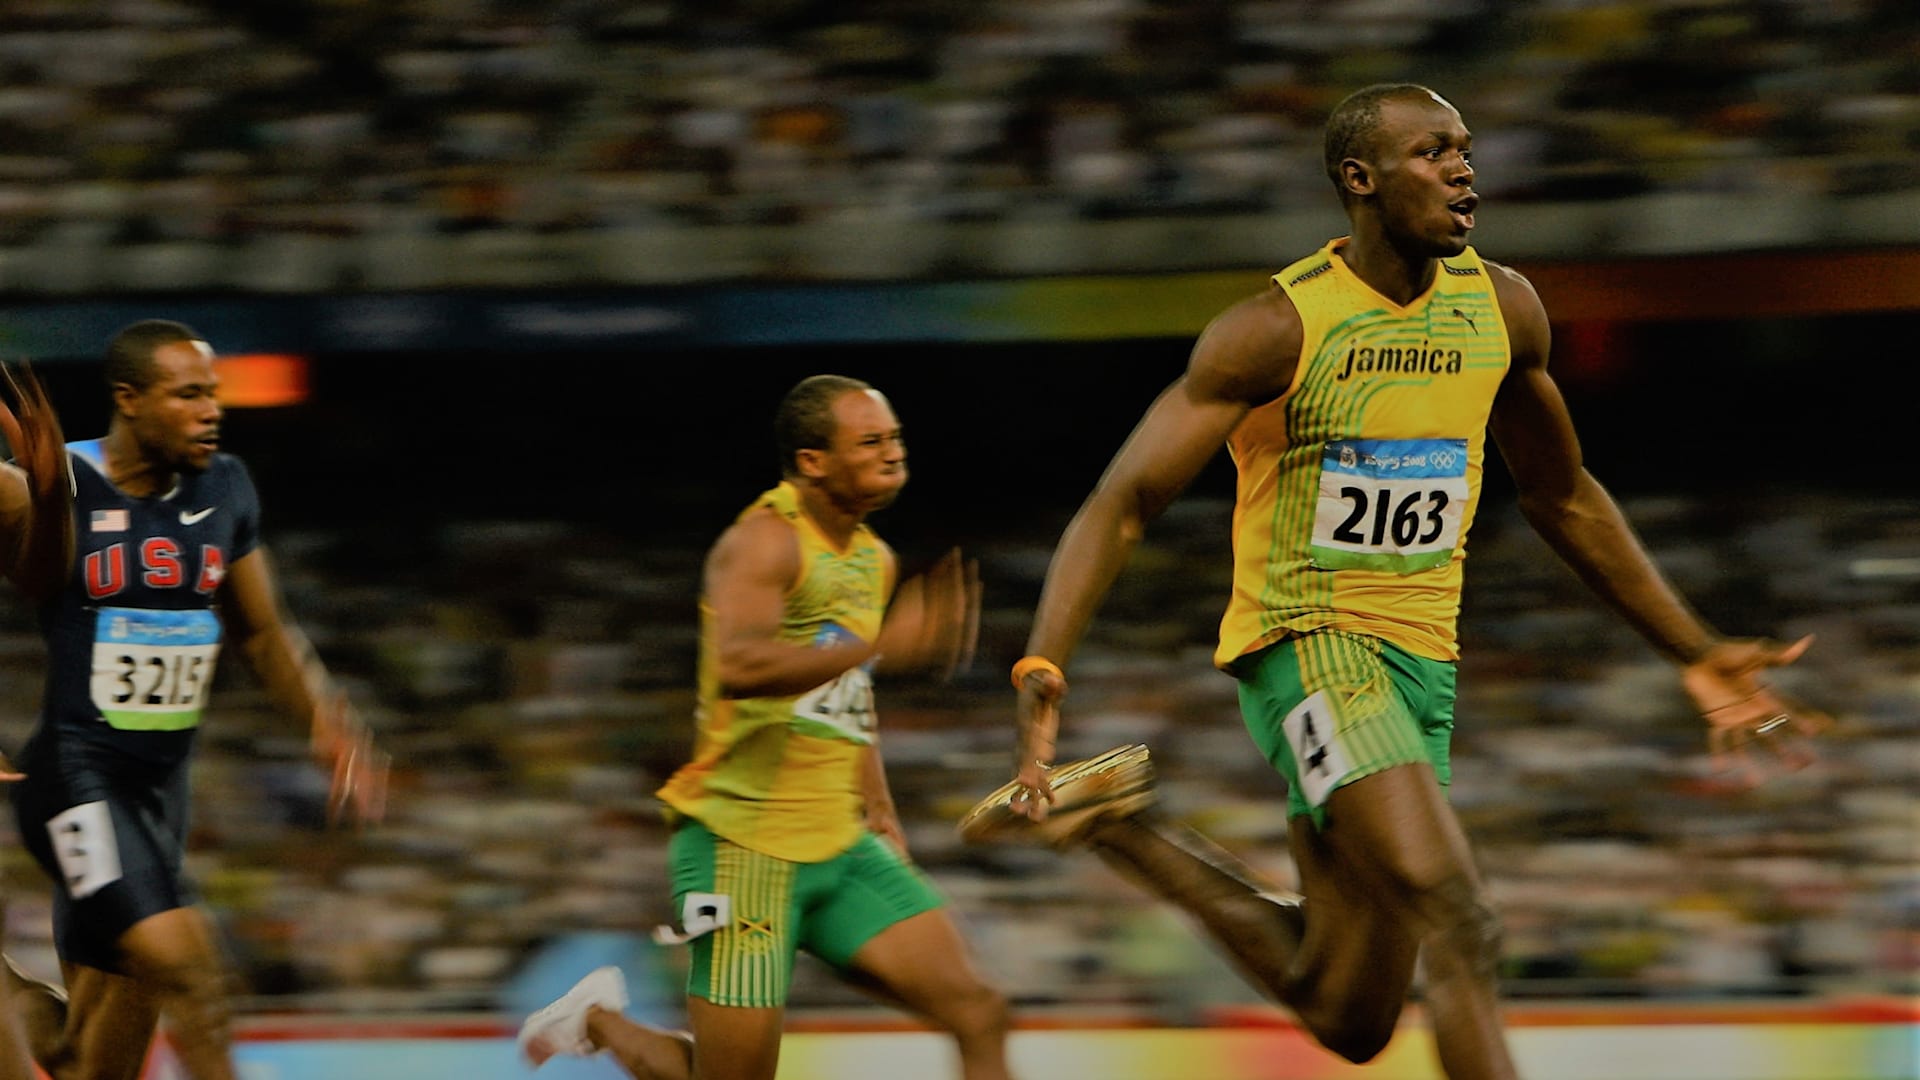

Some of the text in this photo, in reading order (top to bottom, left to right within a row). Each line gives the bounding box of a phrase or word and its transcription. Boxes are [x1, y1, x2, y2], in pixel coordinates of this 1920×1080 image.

[1337, 339, 1463, 381] jamaica
[1402, 454, 1426, 467] 2008
[1332, 486, 1450, 547] 2163
[84, 536, 225, 600] USA
[110, 655, 208, 705] 3215
[1302, 710, 1330, 779] 4
